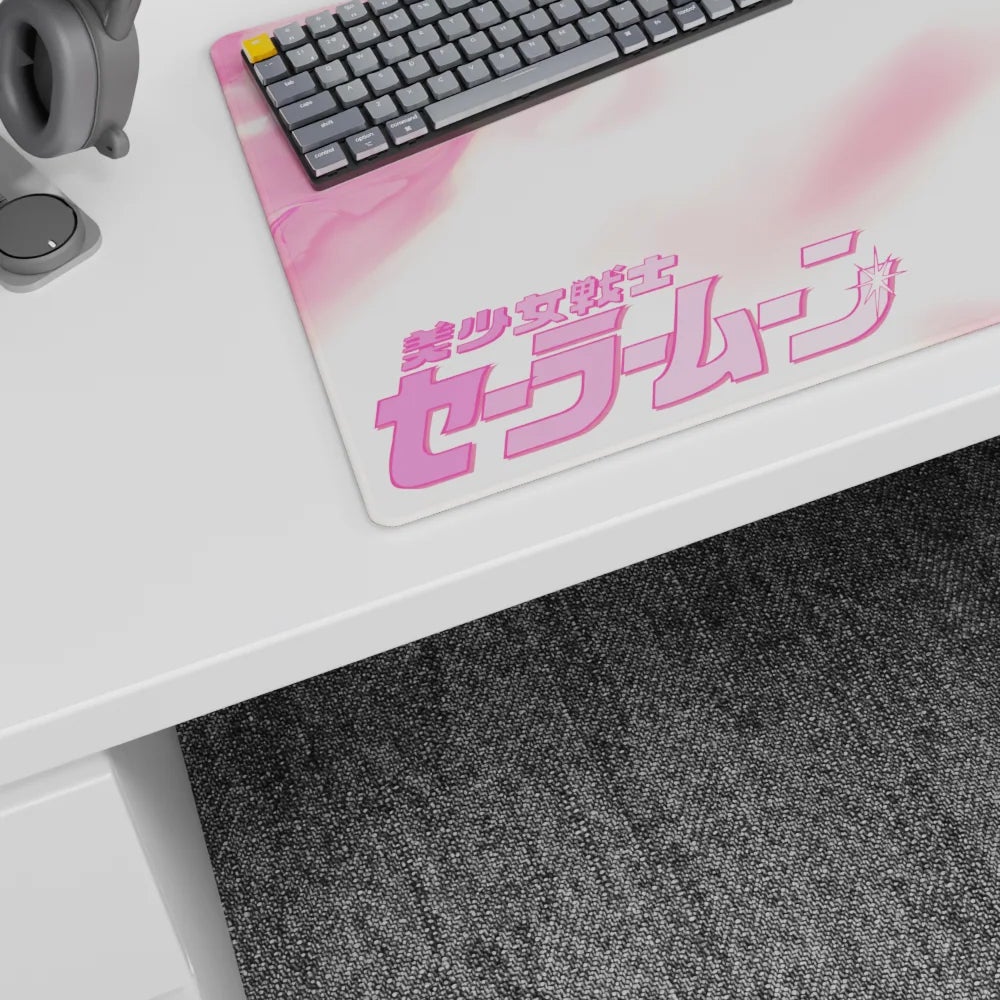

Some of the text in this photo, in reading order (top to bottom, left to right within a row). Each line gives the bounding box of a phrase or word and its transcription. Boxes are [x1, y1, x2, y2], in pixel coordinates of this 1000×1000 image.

[320, 120, 334, 129] shift
[390, 114, 418, 128] command
[355, 131, 375, 142] option
[314, 147, 335, 159] control
[401, 254, 679, 372] 美少女戦士
[374, 229, 904, 490] セーラームーン
